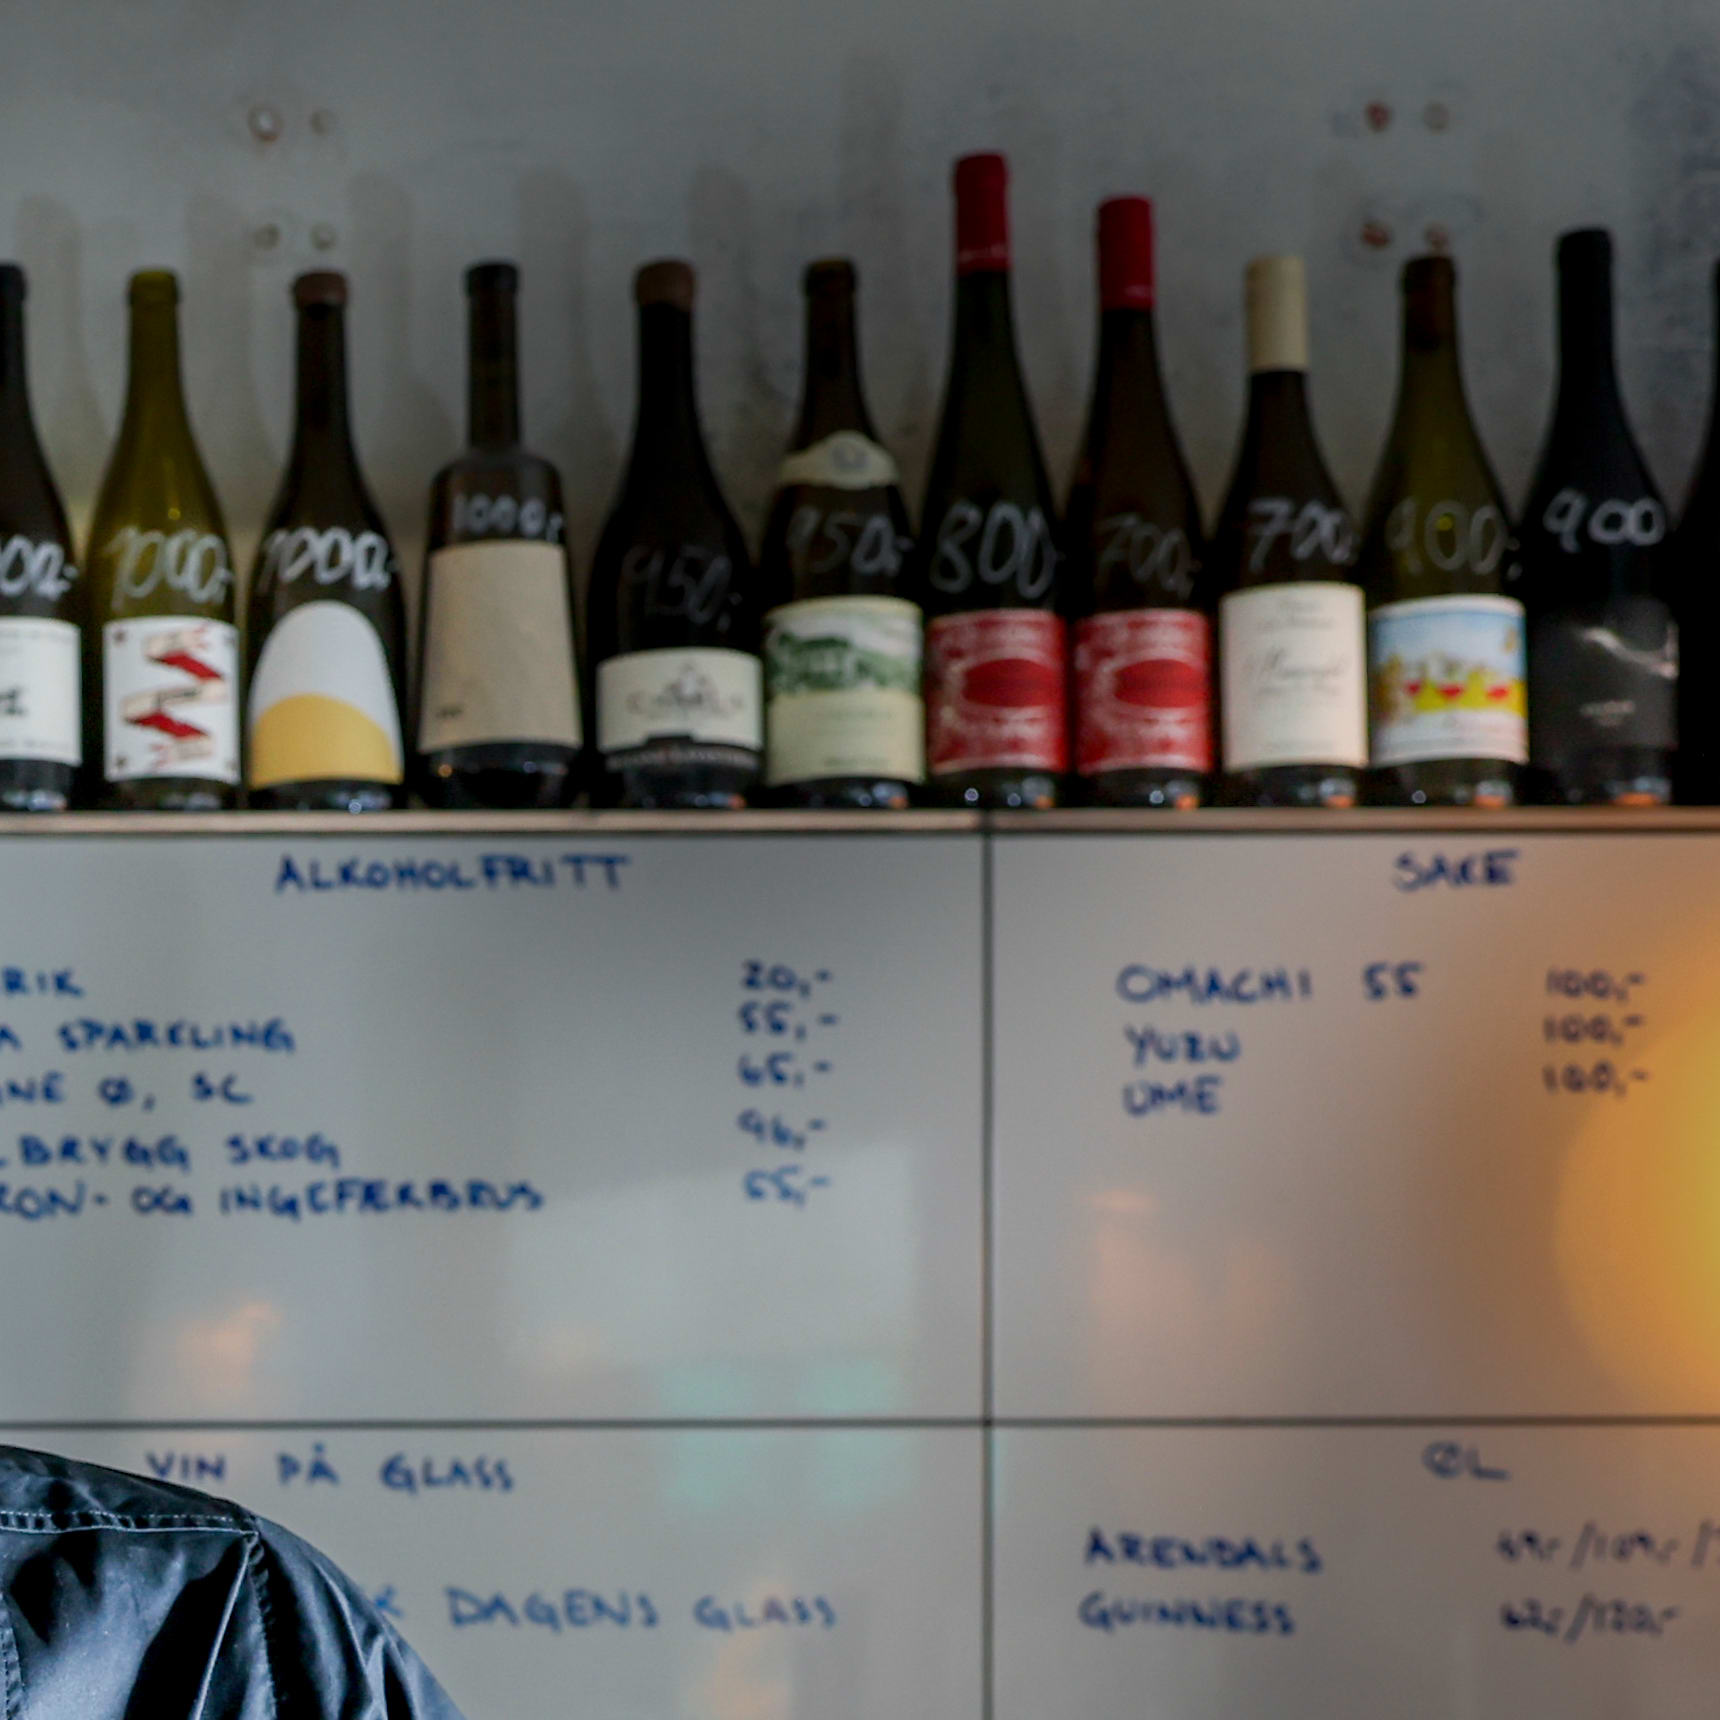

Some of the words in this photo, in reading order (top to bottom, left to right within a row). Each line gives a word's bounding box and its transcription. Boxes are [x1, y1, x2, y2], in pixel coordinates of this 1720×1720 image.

[276, 853, 628, 890] ALKOHOLFRITT
[1397, 849, 1517, 891] SAKE
[1117, 965, 1311, 1004] OMACHI
[58, 1019, 294, 1051] SPARKLING
[148, 1448, 232, 1482] VIN
[277, 1443, 338, 1484] PÅ
[380, 1454, 513, 1493] GLASS
[1086, 1529, 1322, 1574] ARENDALS
[445, 1586, 658, 1632] DAGENS
[692, 1595, 837, 1631] GLASS
[1079, 1592, 1295, 1637] GUINNESS
